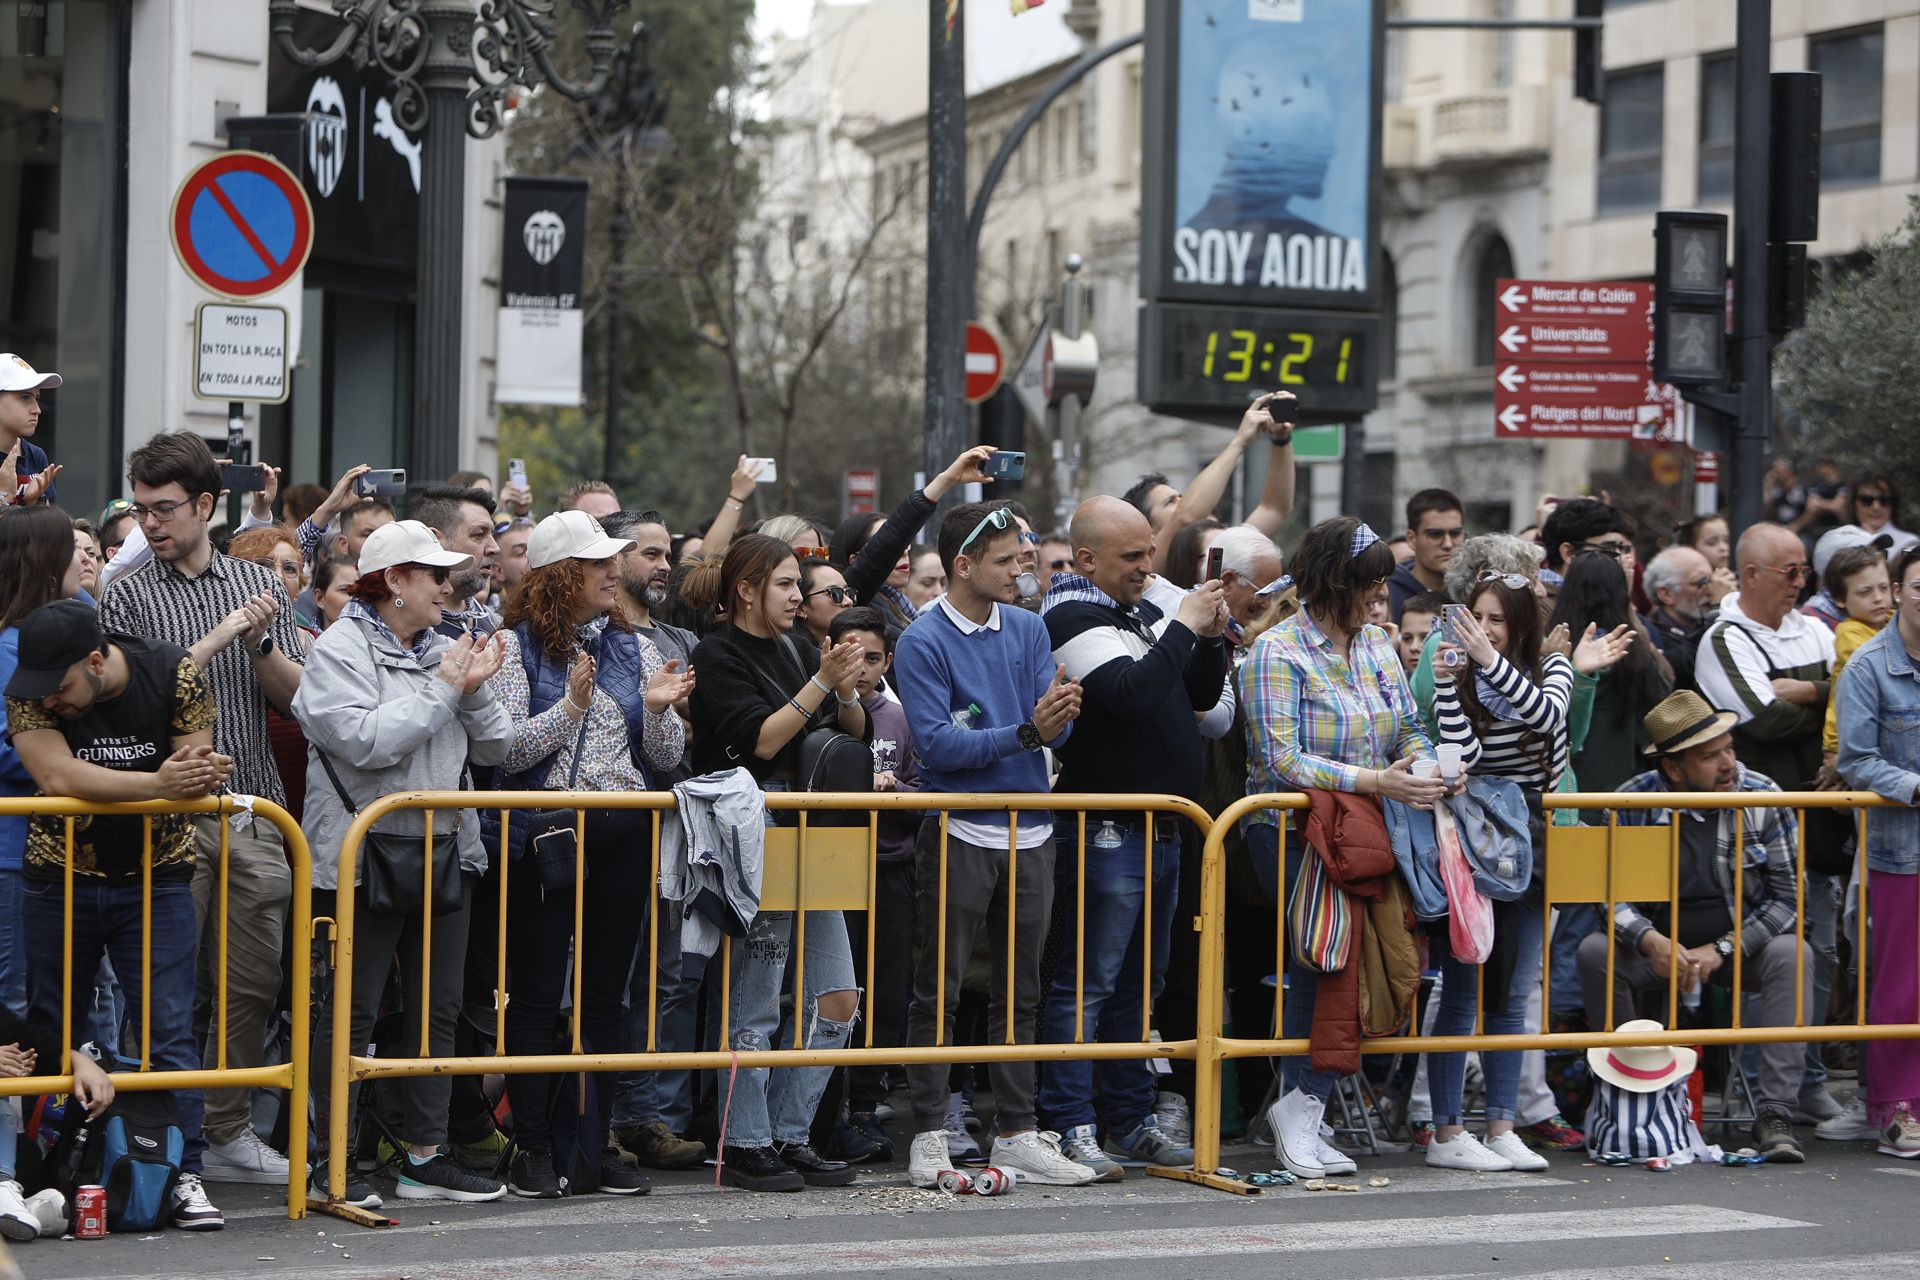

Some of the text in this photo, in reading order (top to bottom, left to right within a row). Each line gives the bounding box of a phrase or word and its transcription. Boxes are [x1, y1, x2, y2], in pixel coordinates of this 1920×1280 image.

[1173, 226, 1368, 293] SOY AQUA
[1531, 286, 1637, 303] Mercat de Colón
[226, 315, 258, 327] MOTOS
[1531, 326, 1608, 342] Universitats
[202, 343, 282, 358] EN TOTA LA PLAÇA
[1202, 330, 1352, 384] 13:21
[200, 371, 282, 387] EN TODA LA PLAZA
[1531, 405, 1635, 423] Platges del Nord
[93, 735, 137, 745] AVENUE
[76, 742, 157, 761] GUNNERS
